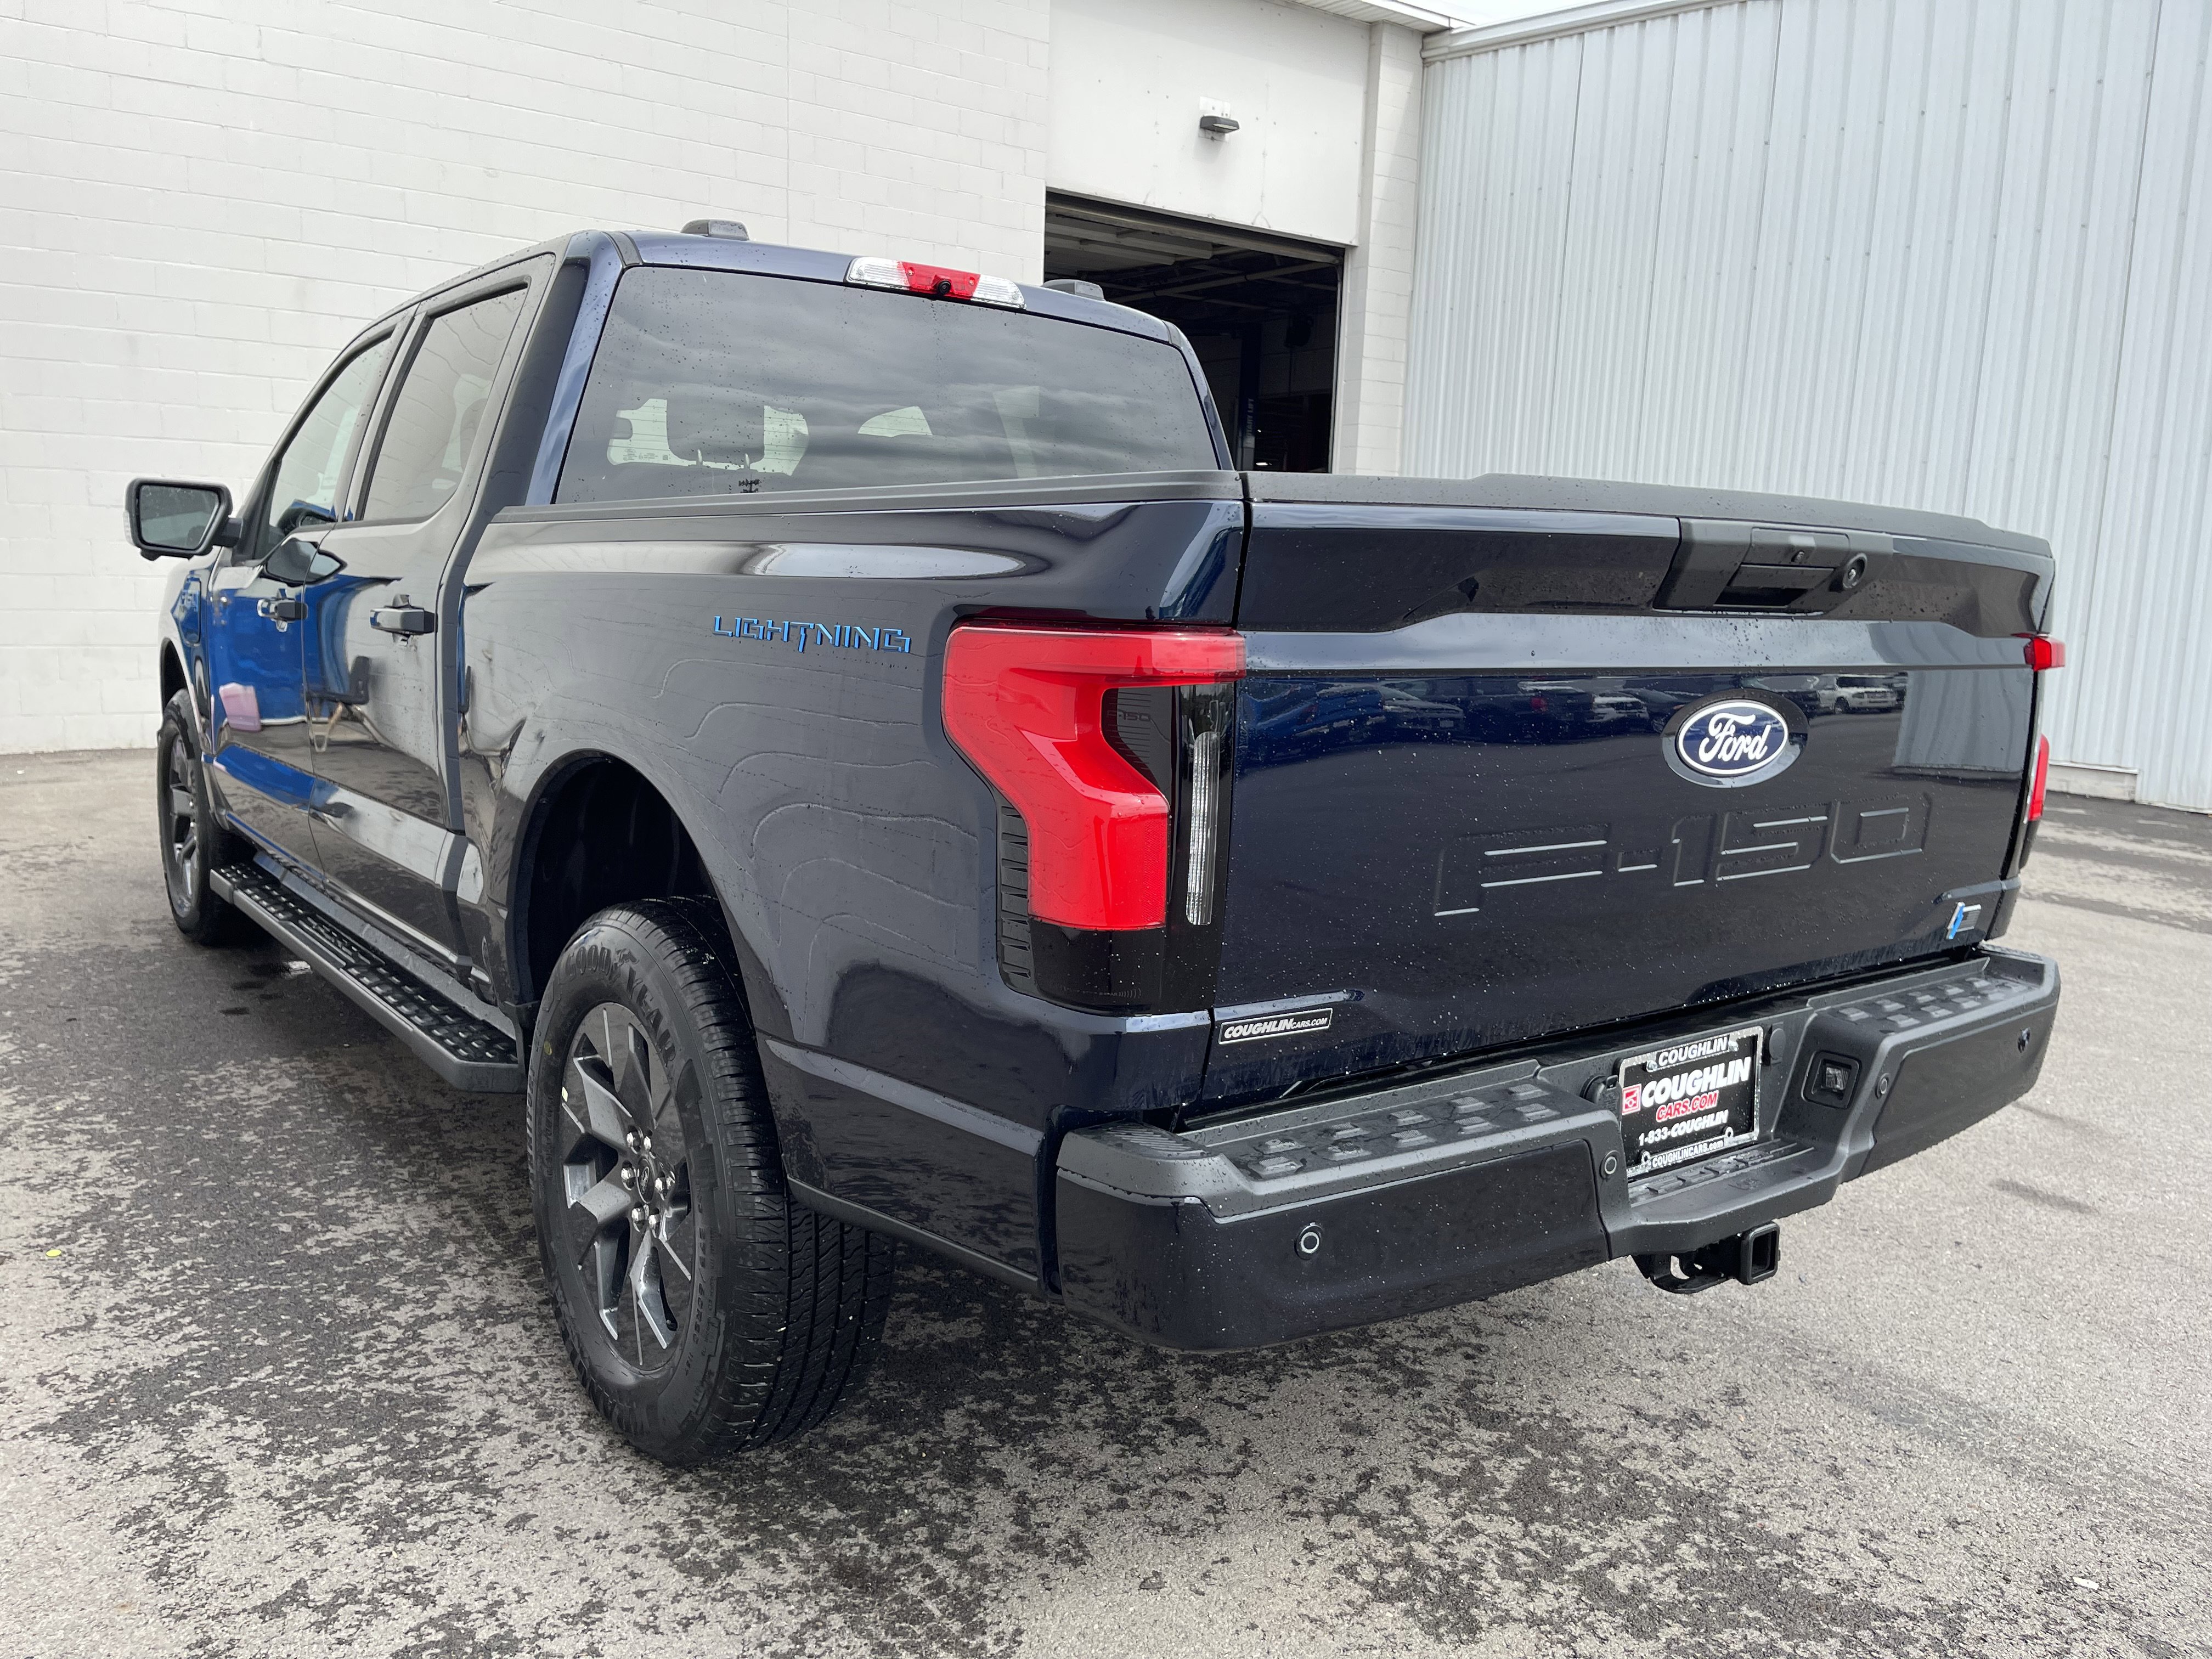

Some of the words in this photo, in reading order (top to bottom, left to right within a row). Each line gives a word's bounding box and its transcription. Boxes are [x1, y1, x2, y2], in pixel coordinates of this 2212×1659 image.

[713, 615, 911, 653] LIGHTNING
[1699, 713, 1771, 763] Ford
[1434, 793, 1932, 917] F-150
[1223, 1017, 1328, 1039] COUGHLINCARS.COM
[1658, 1036, 1729, 1067] COUGHLIN
[1641, 1056, 1752, 1108] COUGHLIN
[1656, 1090, 1719, 1123] CARS.COM
[1638, 1109, 1729, 1147] 1-833-COUGHLIN
[1652, 1139, 1724, 1169] COUGHLINCARS.com
